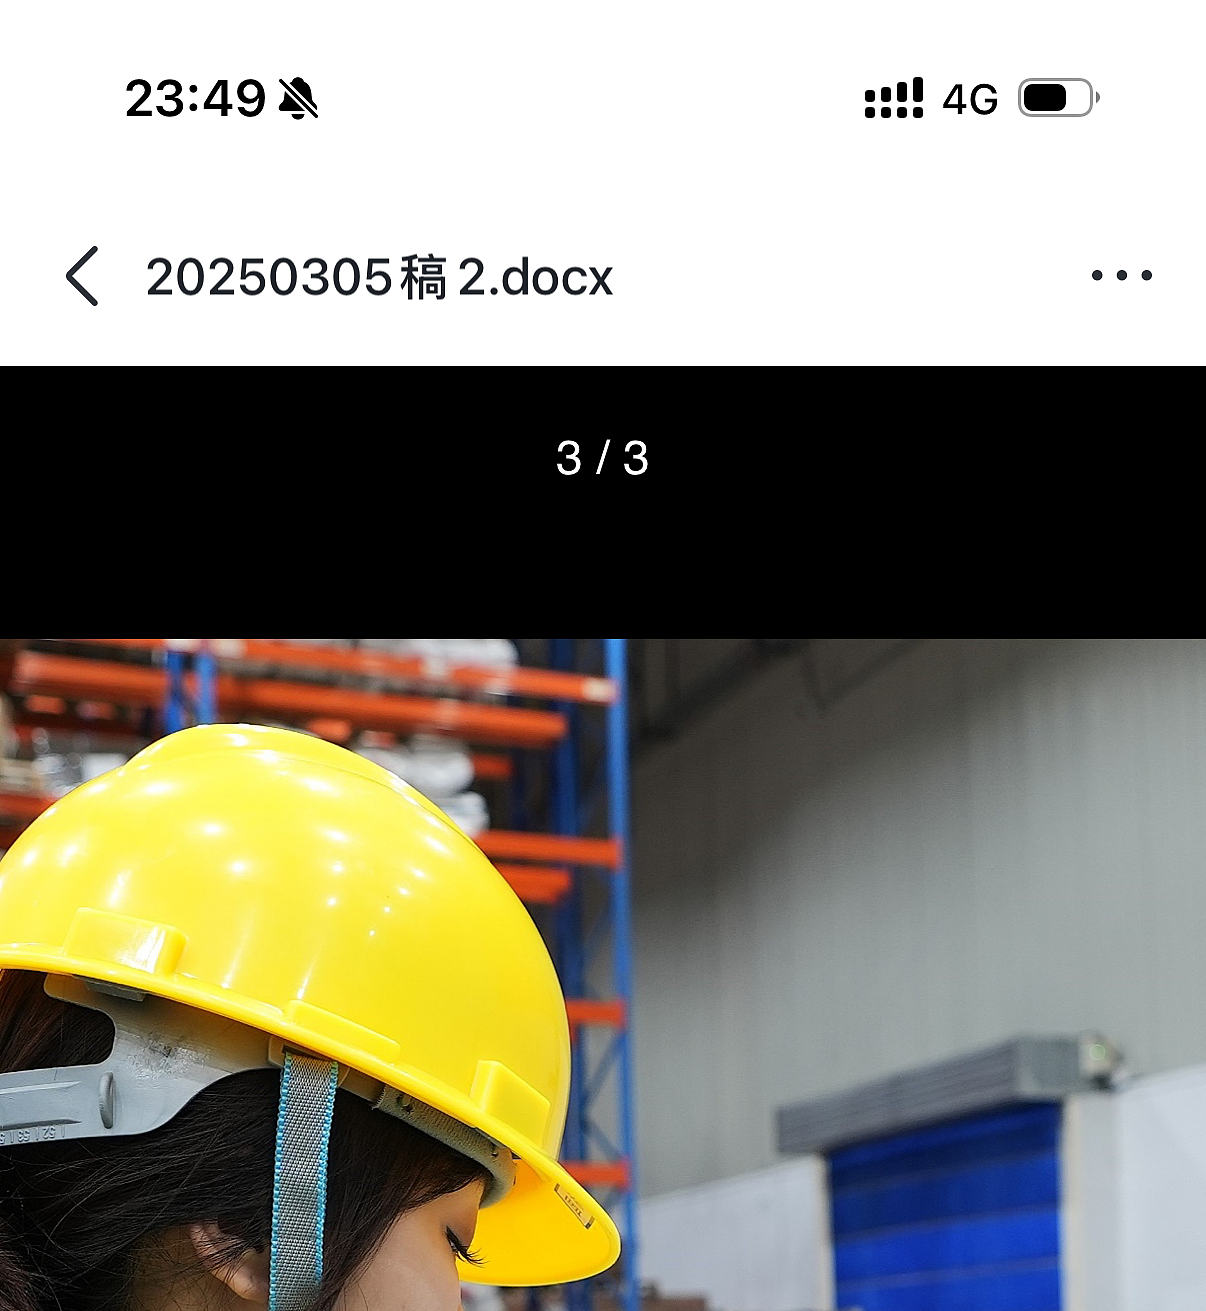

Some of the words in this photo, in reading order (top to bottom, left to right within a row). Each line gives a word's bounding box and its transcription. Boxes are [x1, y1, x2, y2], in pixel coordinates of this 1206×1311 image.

[126, 79, 265, 117] 23:49
[943, 84, 997, 115] 4G
[557, 440, 581, 475] 3
[624, 440, 648, 475] 3
